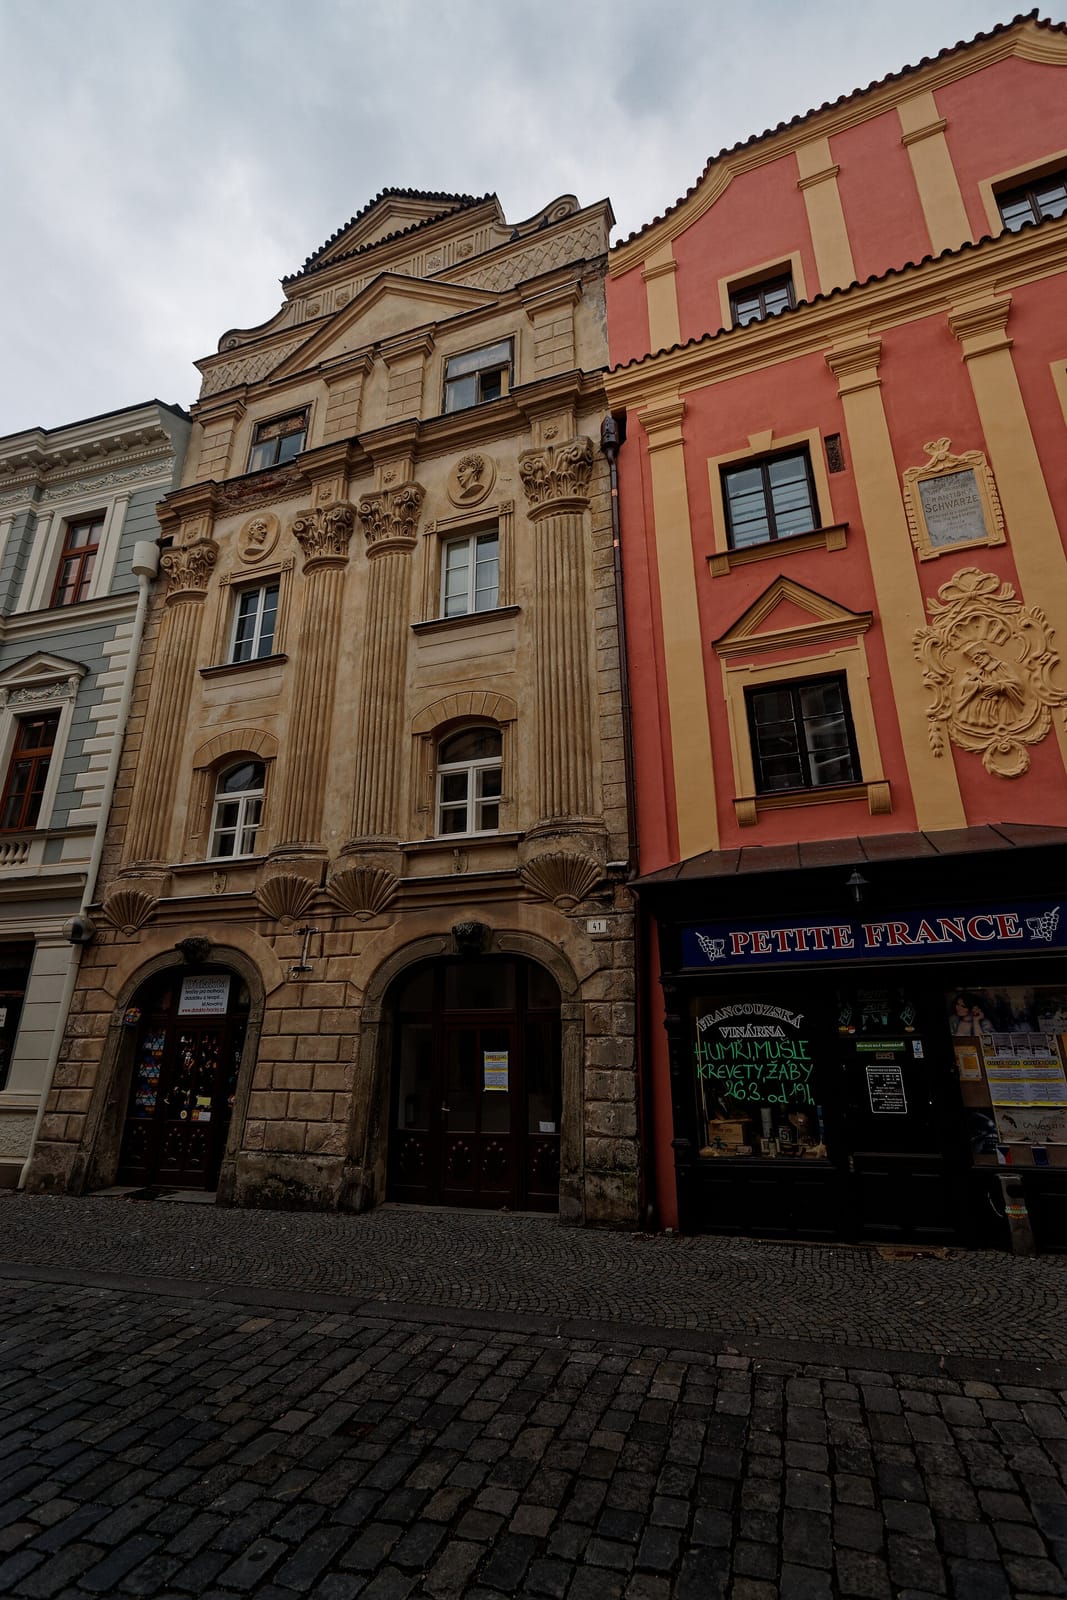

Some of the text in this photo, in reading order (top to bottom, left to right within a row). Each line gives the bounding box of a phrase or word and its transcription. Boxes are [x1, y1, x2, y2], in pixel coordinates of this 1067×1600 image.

[925, 494, 979, 513] SCHWARZE
[729, 913, 1023, 955] PETITE FRANCE
[696, 1003, 804, 1032] FRANCOUZSKÁ
[719, 1023, 786, 1038] VINÁRNA
[724, 1080, 765, 1101] 26.3.
[767, 1082, 789, 1104] od
